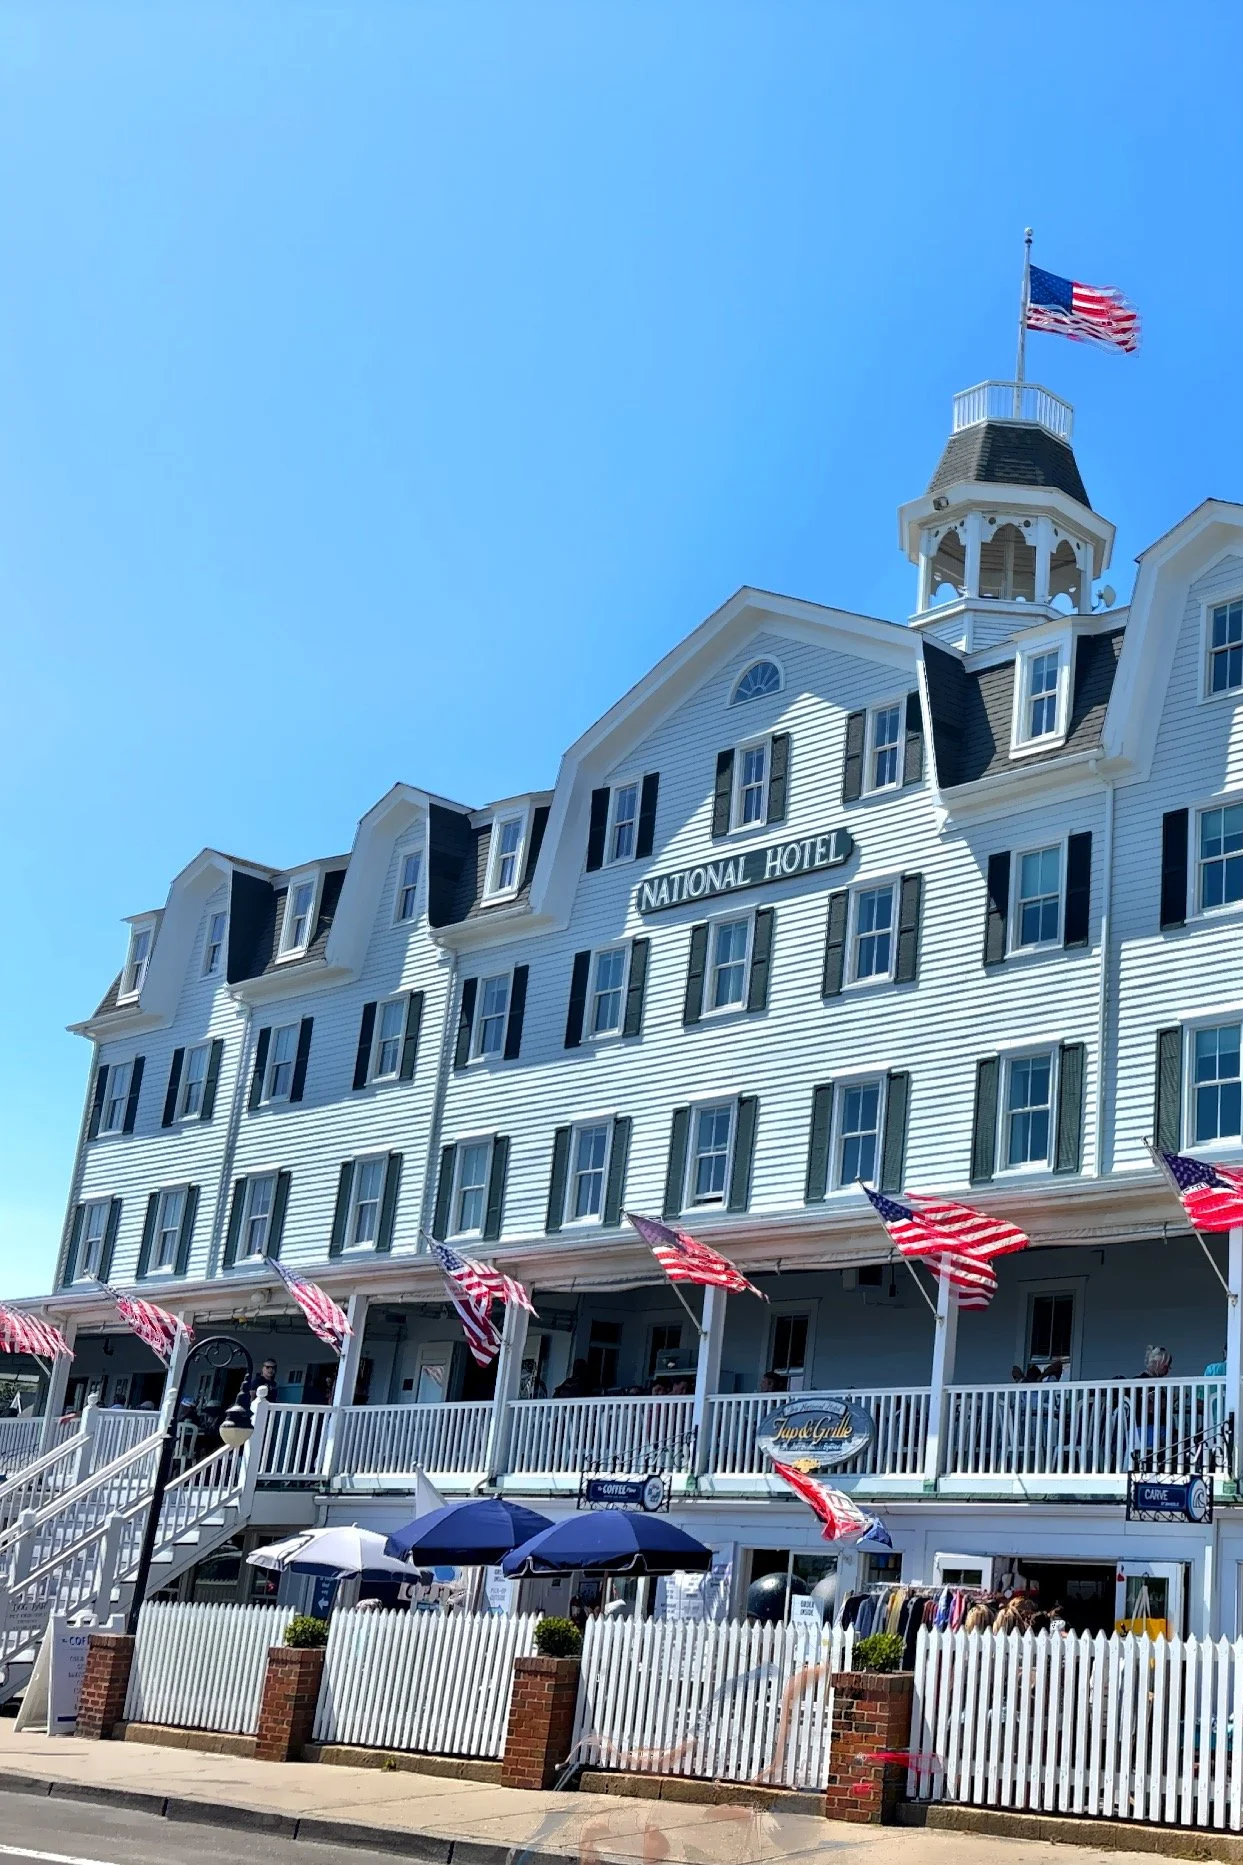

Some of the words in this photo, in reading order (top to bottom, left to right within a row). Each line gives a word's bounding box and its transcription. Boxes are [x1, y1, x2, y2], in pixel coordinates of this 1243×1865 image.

[641, 856, 750, 910] NATIONAL
[763, 831, 844, 879] HOTEL
[603, 1484, 627, 1495] COFFEE
[1144, 1488, 1169, 1501] CARVE
